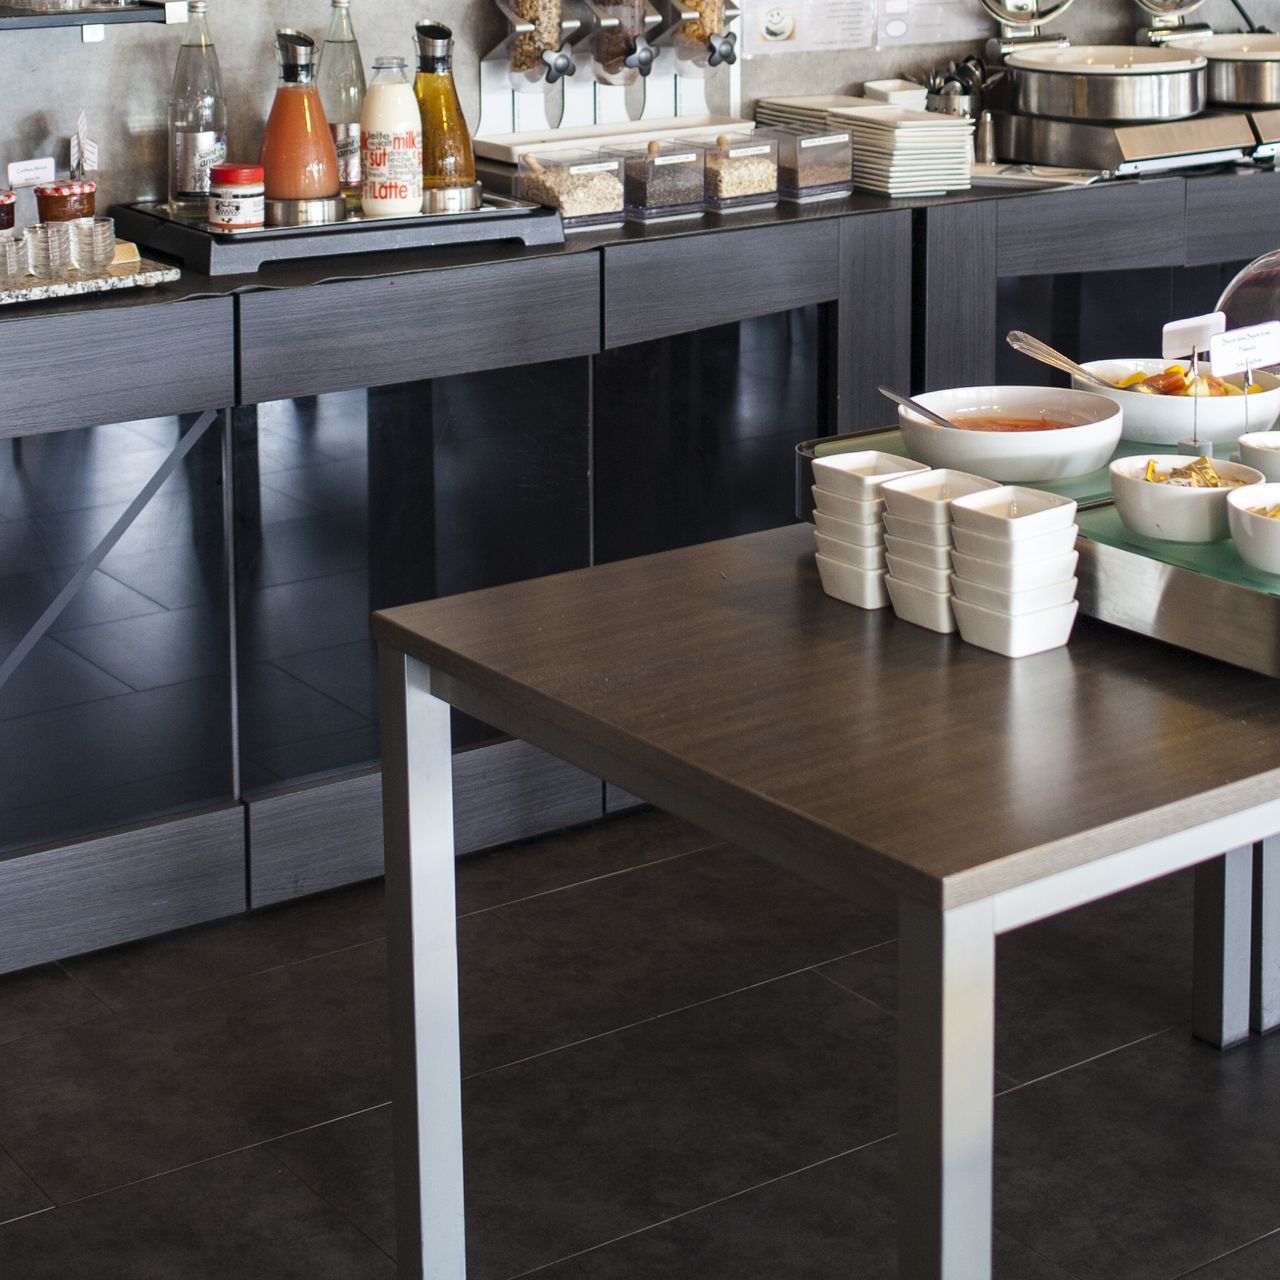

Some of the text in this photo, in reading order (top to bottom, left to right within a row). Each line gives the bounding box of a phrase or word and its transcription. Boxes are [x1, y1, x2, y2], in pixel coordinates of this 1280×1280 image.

[336, 140, 356, 150] saint
[392, 131, 417, 150] milk
[369, 146, 387, 168] süt
[373, 181, 408, 199] Latte
